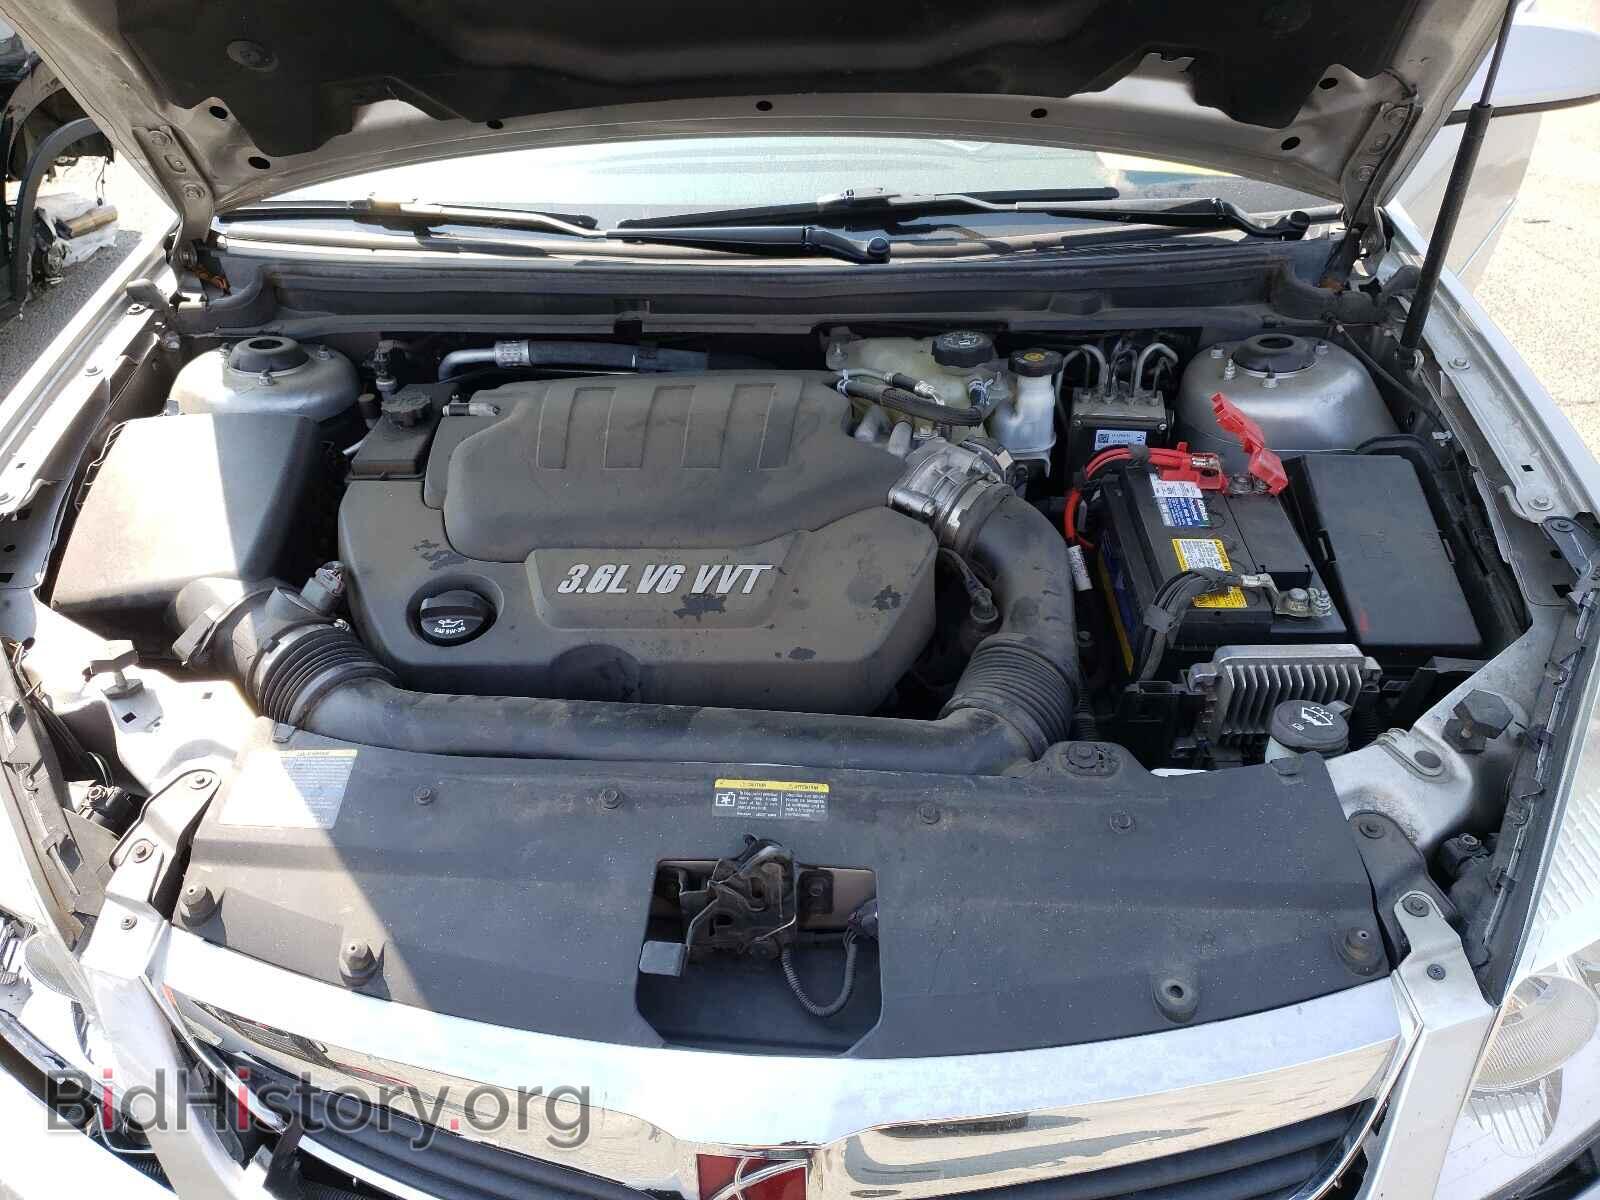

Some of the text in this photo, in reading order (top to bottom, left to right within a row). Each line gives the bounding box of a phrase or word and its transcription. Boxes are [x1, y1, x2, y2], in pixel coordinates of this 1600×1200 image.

[557, 563, 774, 594] 3.6L V6 VVT
